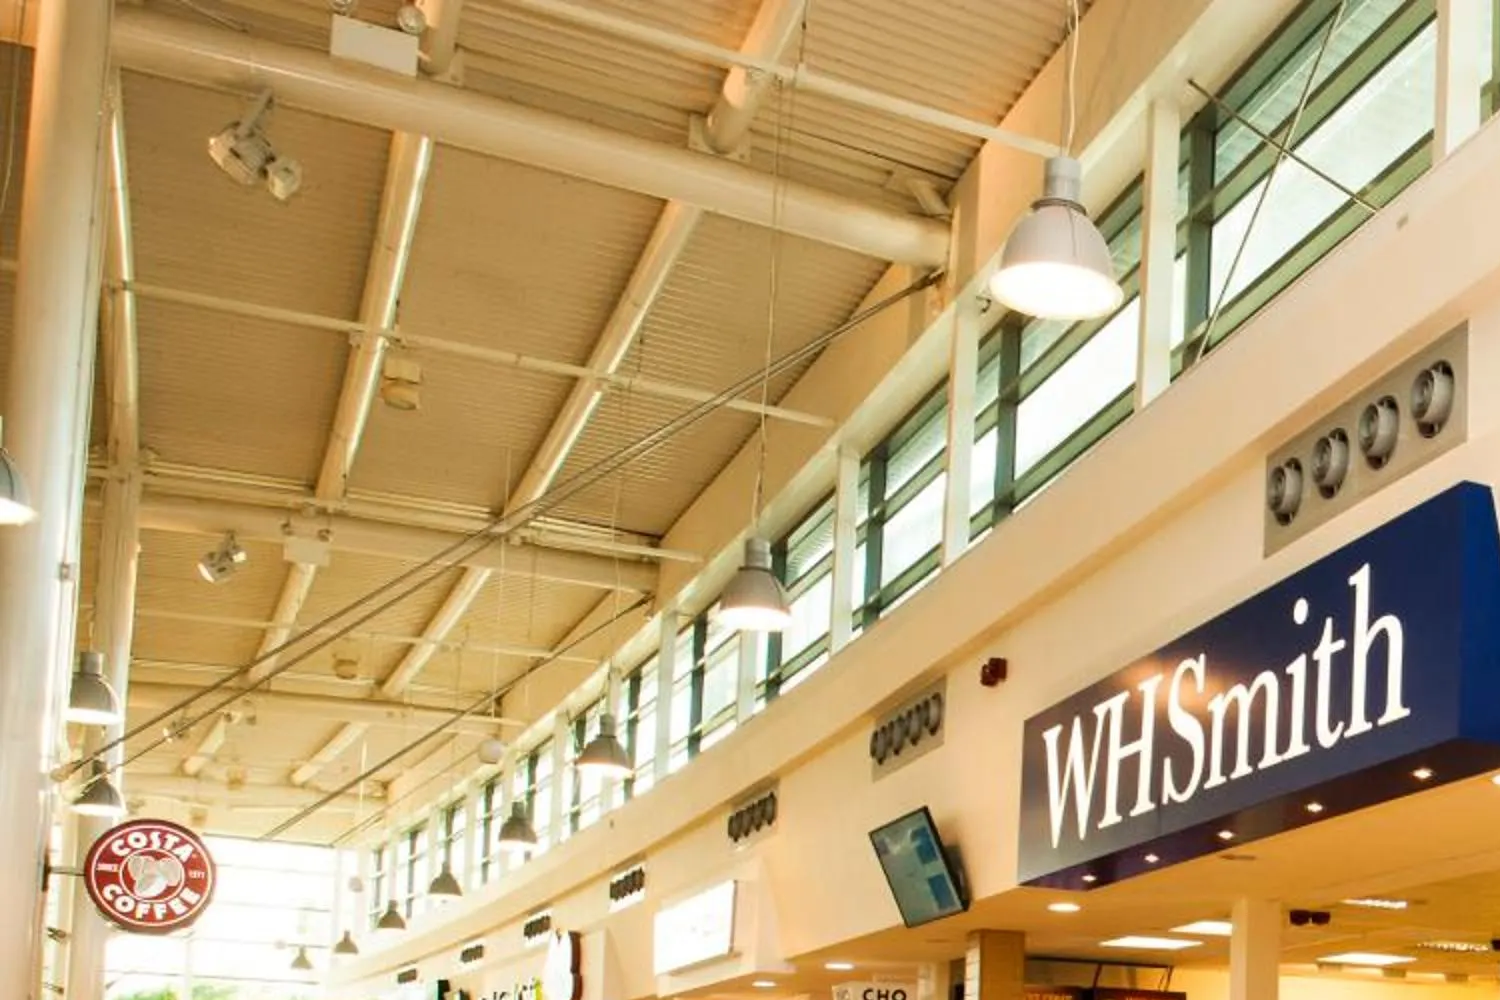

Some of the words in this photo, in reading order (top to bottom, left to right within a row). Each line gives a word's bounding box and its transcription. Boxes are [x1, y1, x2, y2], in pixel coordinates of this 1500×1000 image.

[1043, 563, 1411, 849] WHSmith
[111, 831, 195, 863] COSTA
[102, 884, 201, 920] COFFEE
